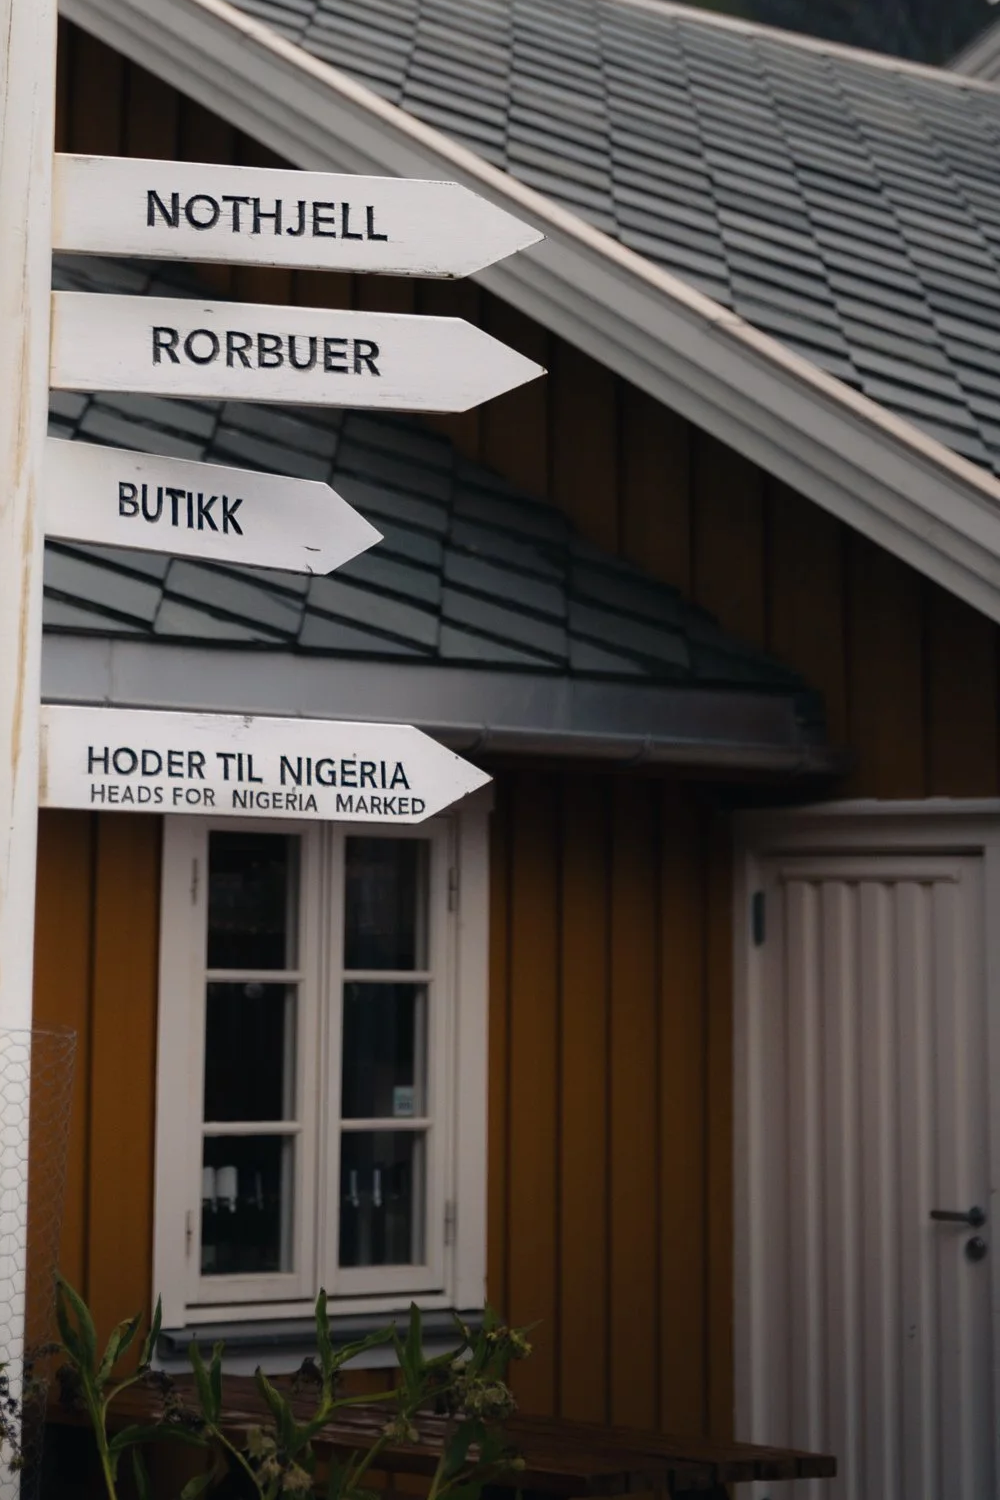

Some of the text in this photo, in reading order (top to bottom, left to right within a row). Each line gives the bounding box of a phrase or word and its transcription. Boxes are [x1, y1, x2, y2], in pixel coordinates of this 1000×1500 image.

[145, 189, 389, 242] NOTHJELL
[151, 325, 382, 377] RORBUER
[117, 480, 244, 536] BUTIKK
[86, 745, 411, 790] HODER TIL NIGERIA
[90, 783, 427, 816] HEADS FOR NIGERIA MARKED
